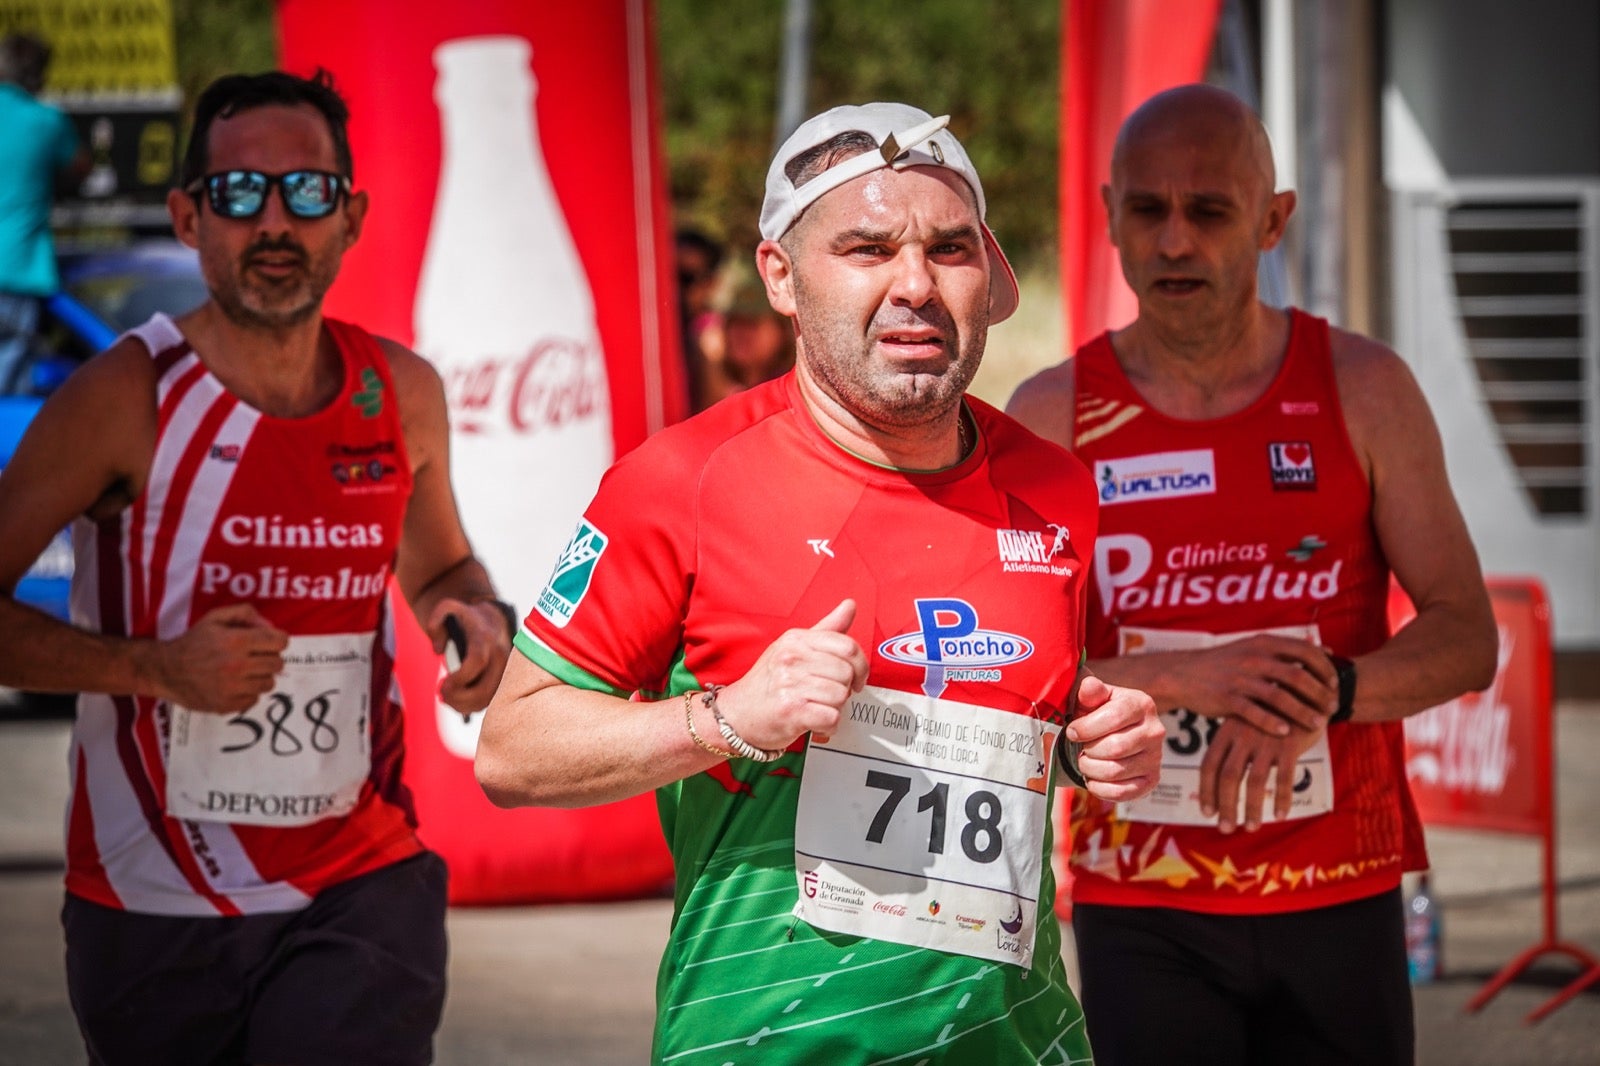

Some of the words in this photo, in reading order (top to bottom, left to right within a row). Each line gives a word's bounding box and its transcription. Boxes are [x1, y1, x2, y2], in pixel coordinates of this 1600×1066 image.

[221, 514, 383, 547] Clínicas
[1166, 541, 1268, 569] Clínicas
[202, 562, 388, 600] Polisalud
[1094, 533, 1343, 617] Polisalud
[914, 598, 1015, 662] Poncho
[946, 669, 1001, 681] PINTURAS
[850, 700, 881, 725] XXXV
[1008, 731, 1036, 757] 2022
[865, 769, 1003, 864] 718
[820, 880, 867, 897] Diputación
[829, 893, 865, 906] Granada
